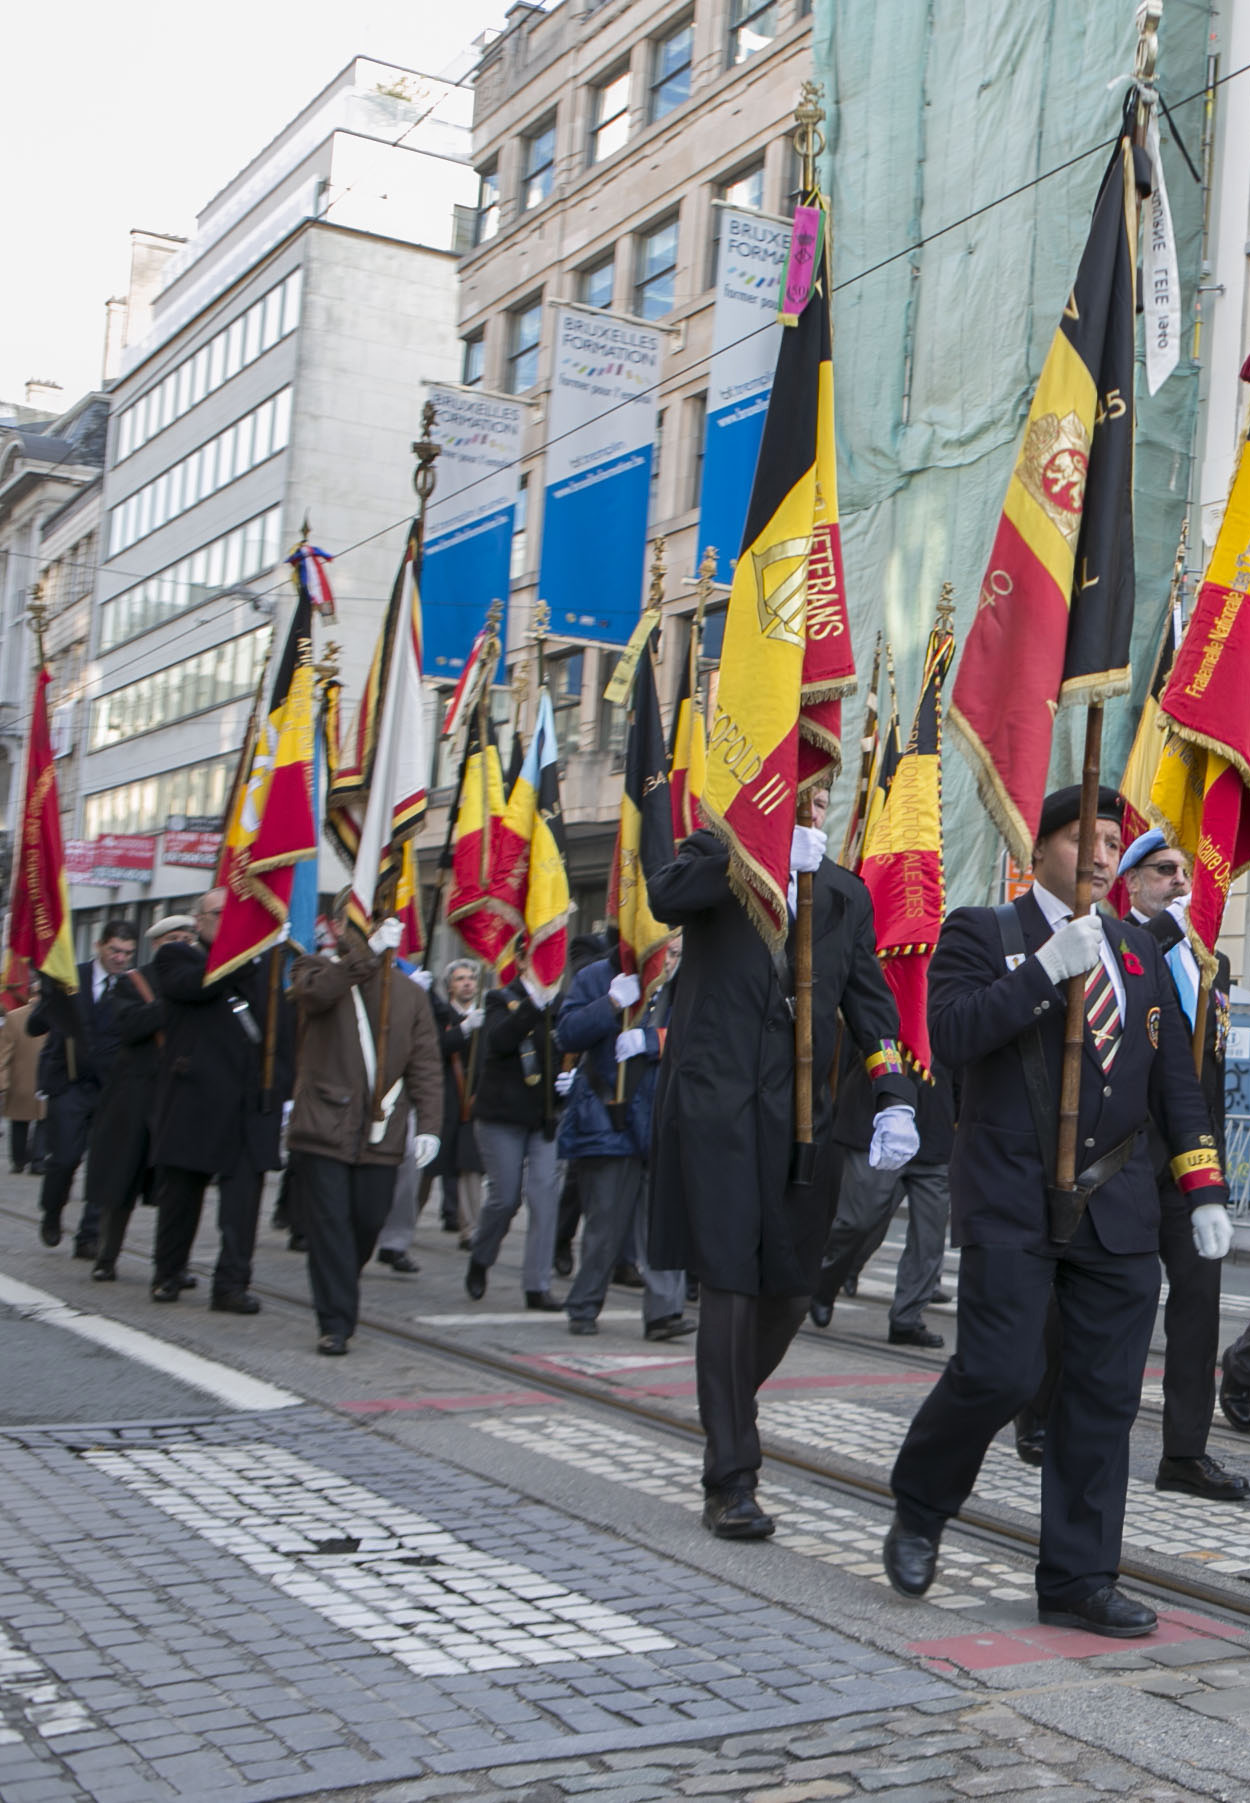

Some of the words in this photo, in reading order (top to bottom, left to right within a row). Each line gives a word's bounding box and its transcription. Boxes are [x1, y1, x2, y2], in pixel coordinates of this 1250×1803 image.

[562, 334, 657, 367] FORMATION
[564, 317, 657, 351] BRUXELLES
[432, 393, 520, 421] BRUXELLES
[807, 517, 844, 642] VETERANS
[1185, 641, 1224, 699] Fraternelle
[1208, 590, 1246, 643] Nationale
[751, 772, 792, 816] III
[901, 793, 924, 884] NATIONALE
[905, 885, 924, 919] DES
